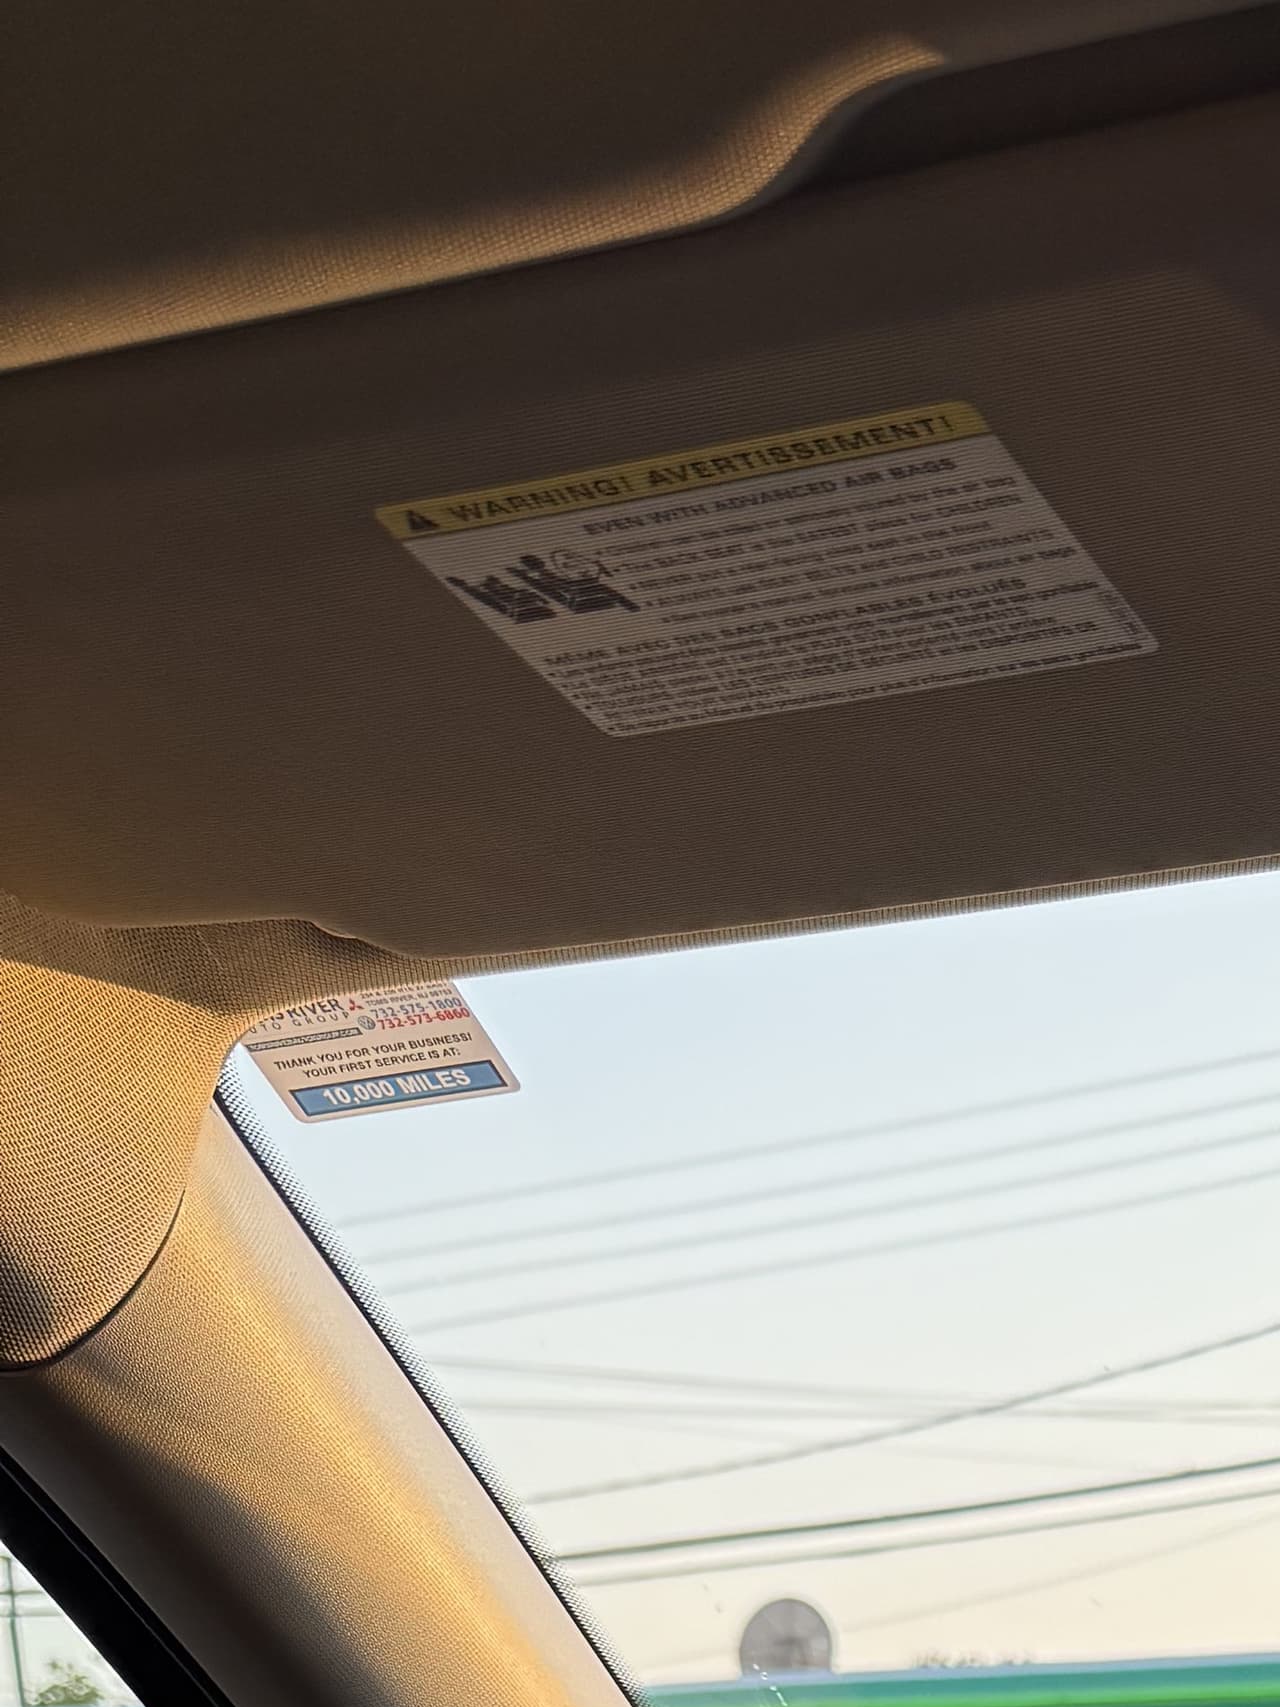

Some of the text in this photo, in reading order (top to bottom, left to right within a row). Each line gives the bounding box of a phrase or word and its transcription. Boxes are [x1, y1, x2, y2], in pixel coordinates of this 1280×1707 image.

[449, 414, 955, 522] WARNING! AVERTISSEMENT!
[582, 457, 958, 536] EVEN WITH ADVANCED AIR BAGS
[370, 997, 462, 1019] 732-575-1800
[377, 1007, 470, 1030] 732-573-6860
[274, 1032, 472, 1071] THANK YOU FOR YOUR BUSINESS!
[303, 1048, 461, 1079] YOUR FIRST SERVICE IS AT:
[322, 1069, 471, 1107] 10,000 MILES
